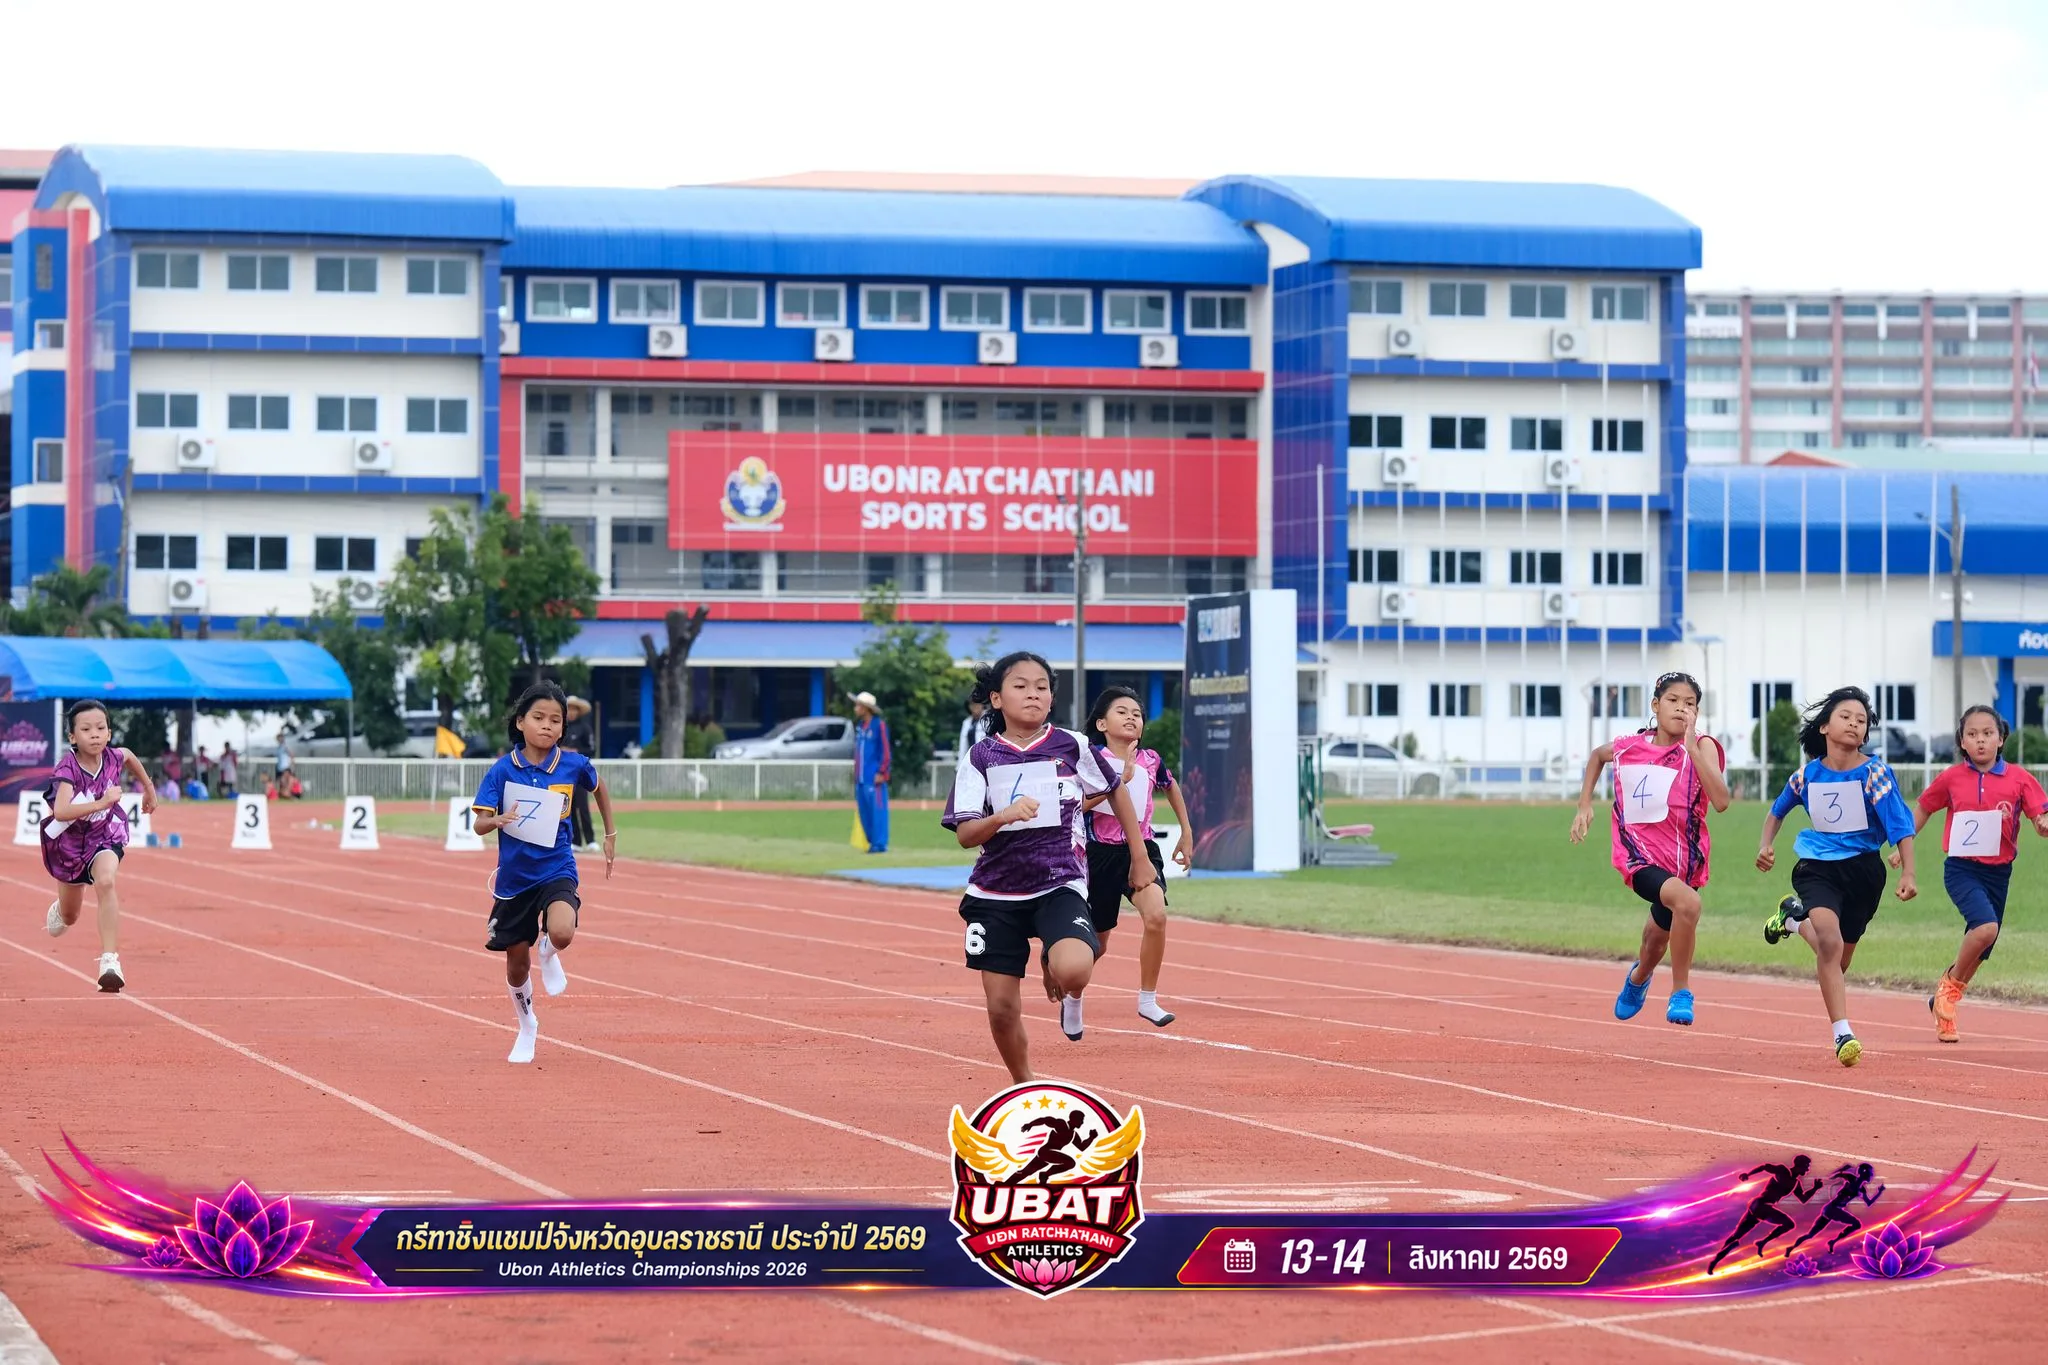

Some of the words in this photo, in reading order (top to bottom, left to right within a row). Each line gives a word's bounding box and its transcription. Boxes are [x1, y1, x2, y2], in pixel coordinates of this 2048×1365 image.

[823, 463, 1155, 497] UBONRATCHATHANI
[861, 501, 987, 531] SPORTS
[1003, 503, 1130, 535] SCHOOL
[1632, 774, 1653, 809] 4
[27, 801, 42, 826] 5
[127, 803, 140, 828] 4
[245, 804, 259, 828] 3
[352, 806, 367, 830] 2
[459, 806, 471, 831] 1
[515, 799, 542, 828] 7
[1822, 792, 1843, 824] 3
[1962, 819, 1979, 846] 2
[965, 922, 986, 955] 6
